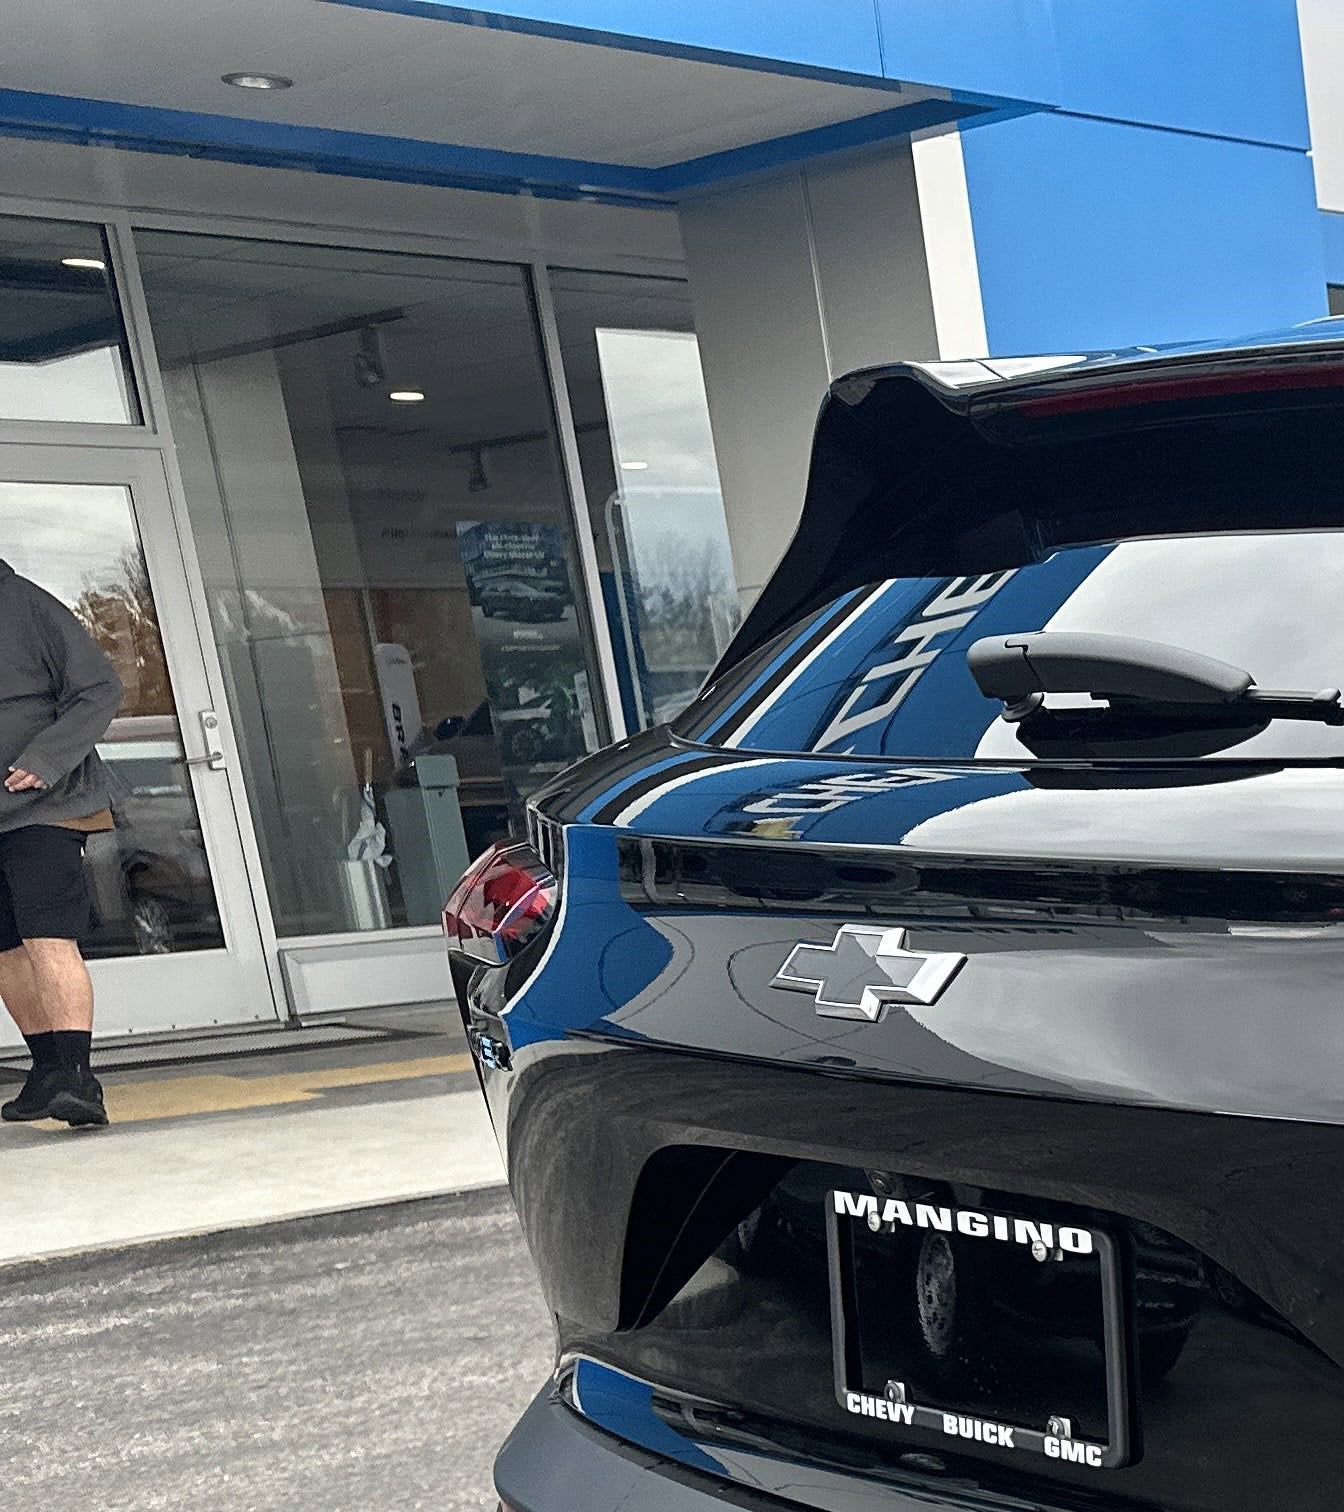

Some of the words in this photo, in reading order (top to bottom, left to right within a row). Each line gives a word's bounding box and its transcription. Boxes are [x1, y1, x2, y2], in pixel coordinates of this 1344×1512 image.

[834, 1190, 1093, 1254] MANGINO
[846, 1392, 915, 1425] CHEVY
[943, 1413, 1015, 1448] BUICK
[1043, 1435, 1102, 1467] GMC
